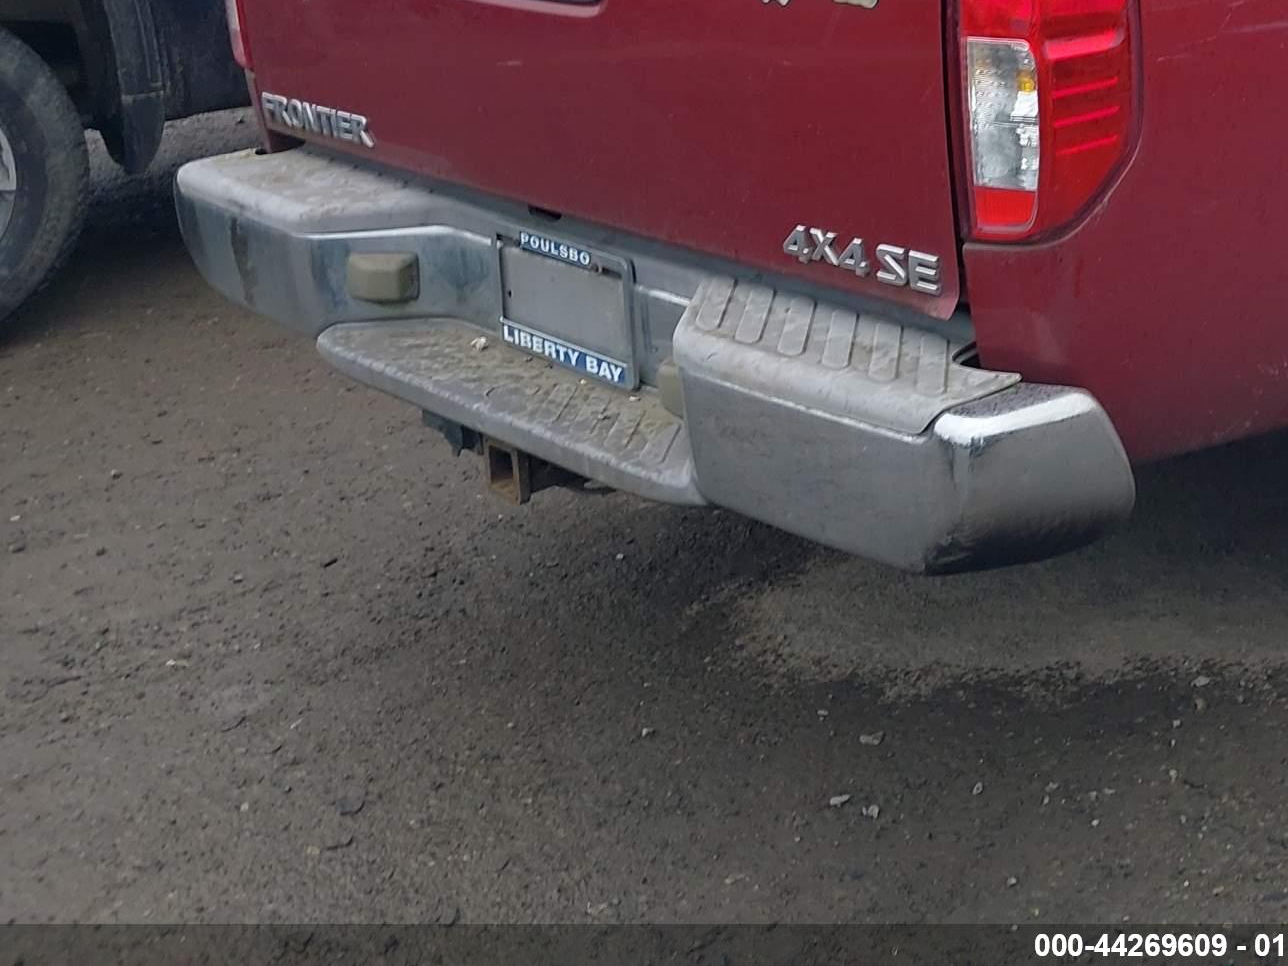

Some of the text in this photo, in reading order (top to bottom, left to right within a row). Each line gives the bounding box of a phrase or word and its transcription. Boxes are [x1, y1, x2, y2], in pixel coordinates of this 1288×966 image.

[261, 92, 375, 148] FRONTIER
[520, 232, 591, 266] POULSBO
[876, 243, 942, 296] SE
[503, 324, 623, 383] LIBERTY BAY
